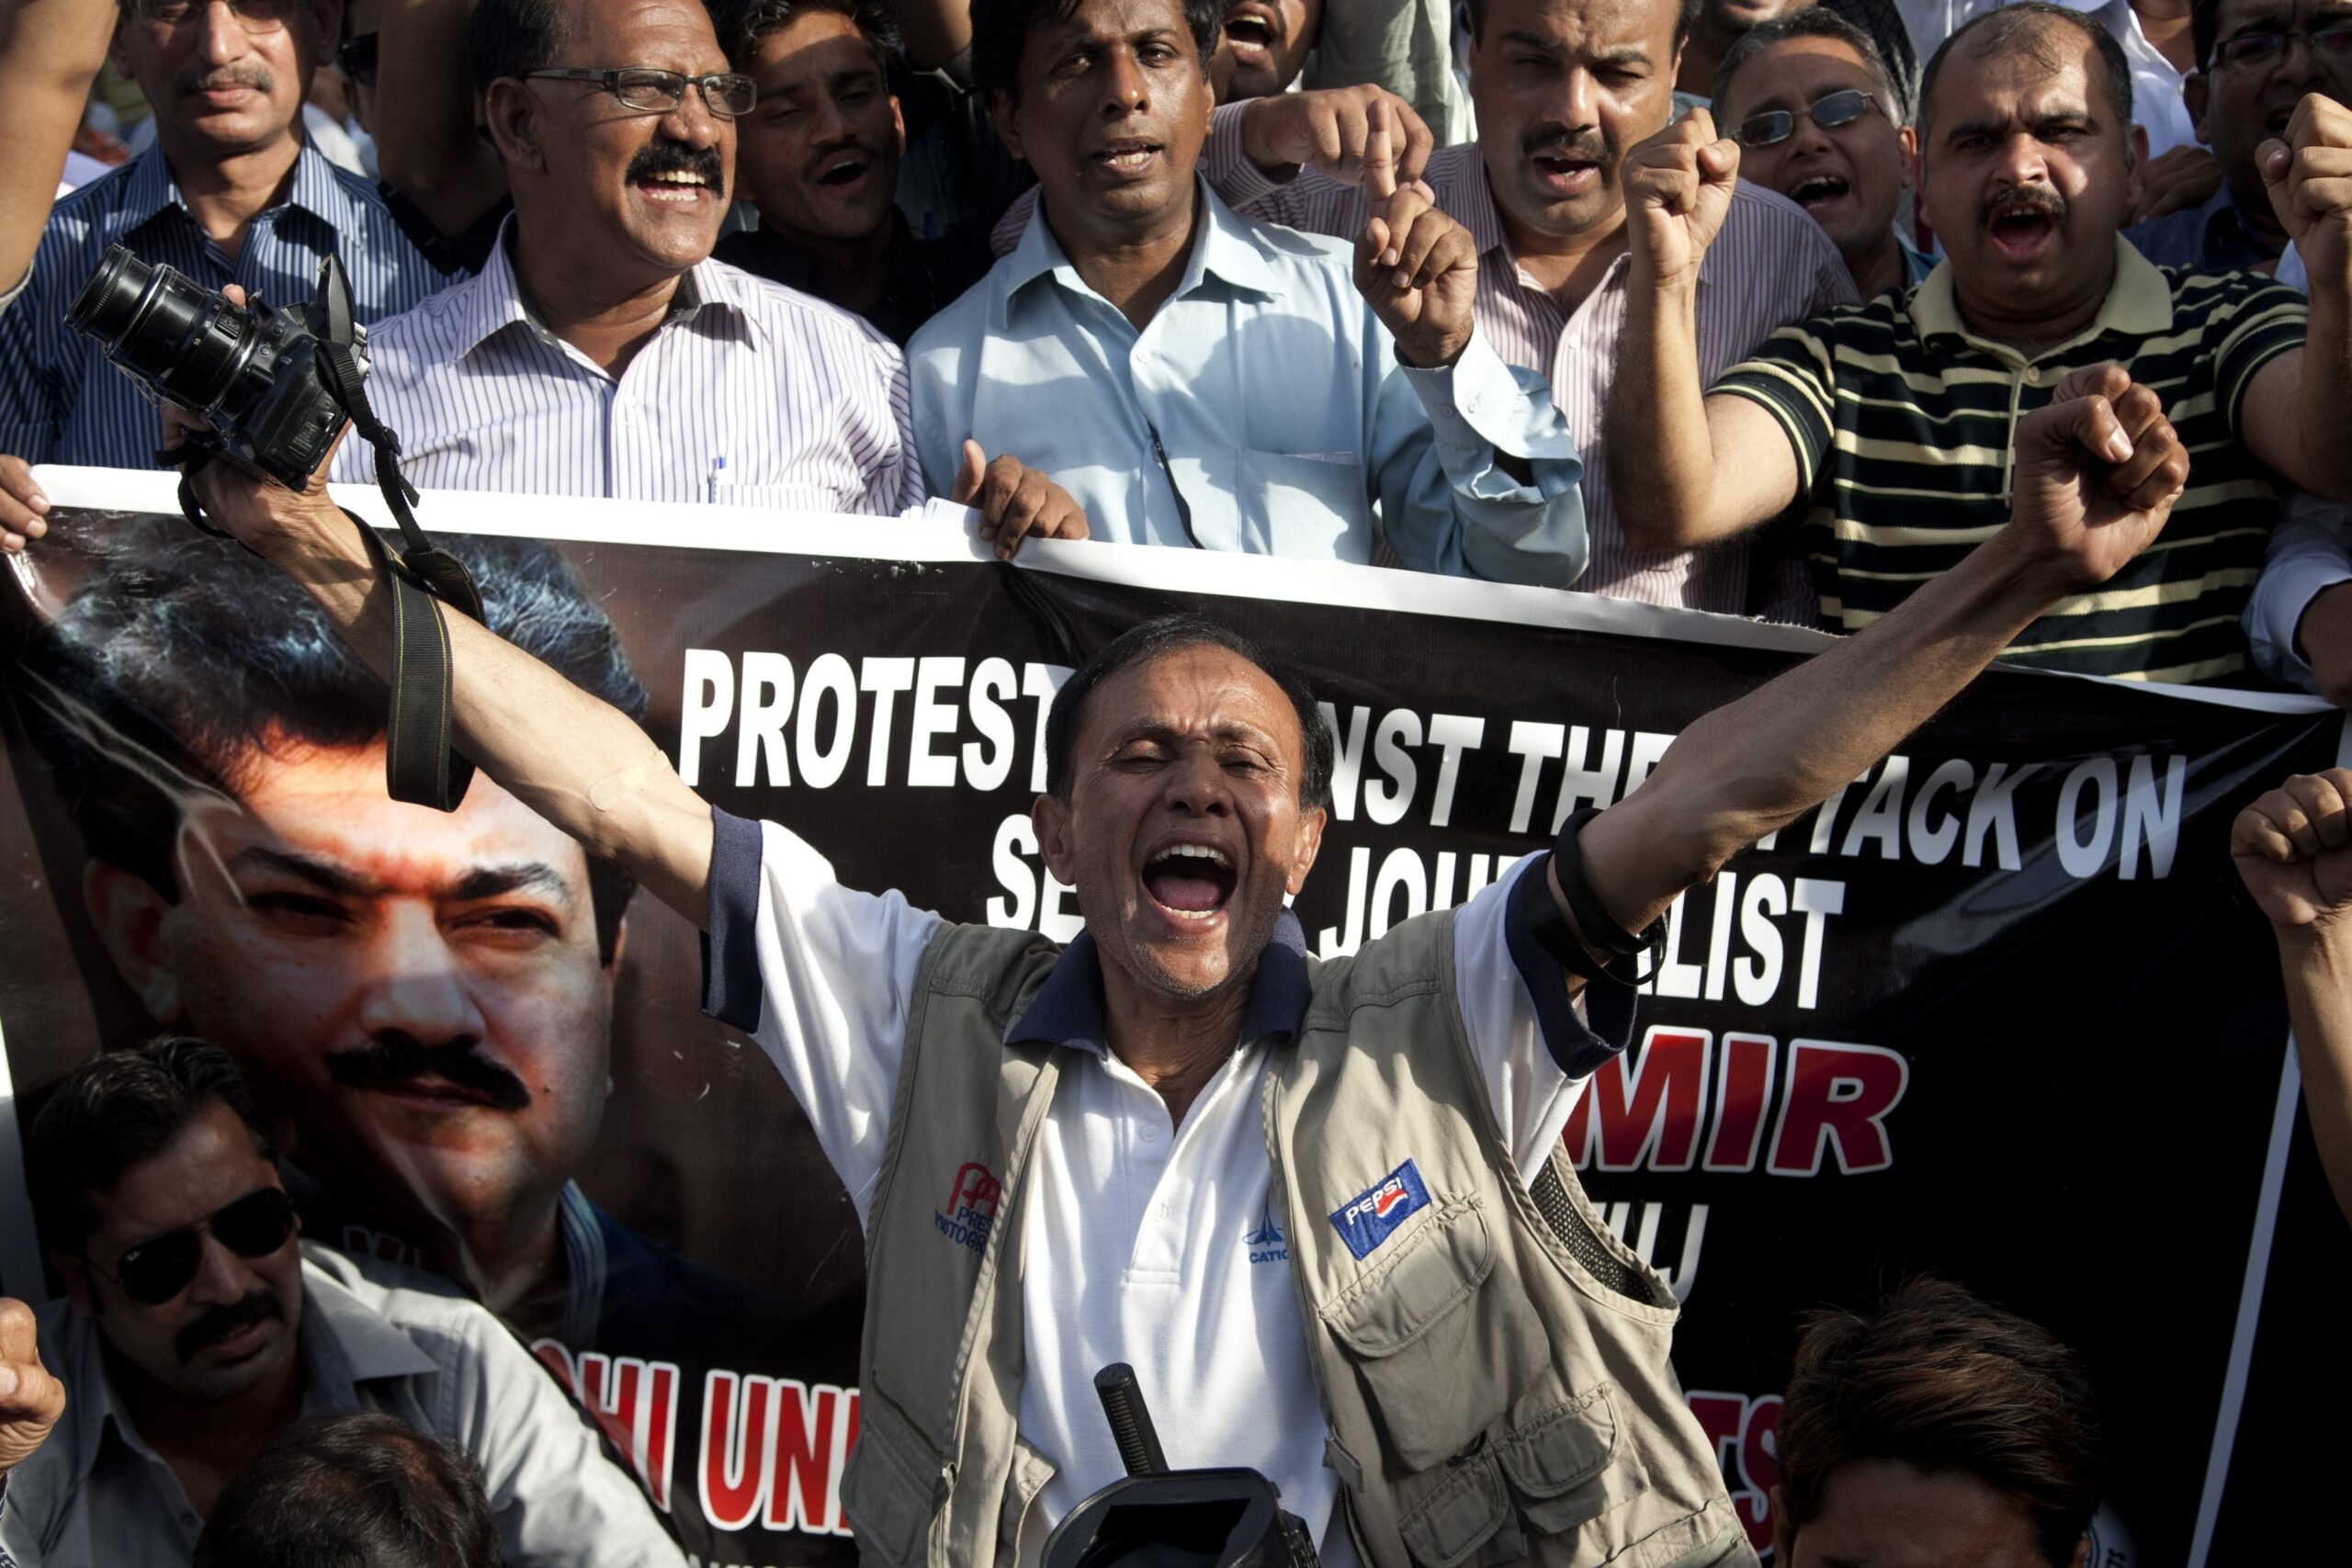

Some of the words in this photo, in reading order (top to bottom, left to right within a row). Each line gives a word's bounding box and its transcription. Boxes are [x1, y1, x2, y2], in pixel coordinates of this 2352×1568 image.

[679, 648, 1077, 793] PROTEST
[2055, 754, 2187, 881] ON
[1570, 1025, 1909, 1178] MIR
[956, 1206, 993, 1235] PRES
[1345, 1177, 1403, 1225] PEPSI
